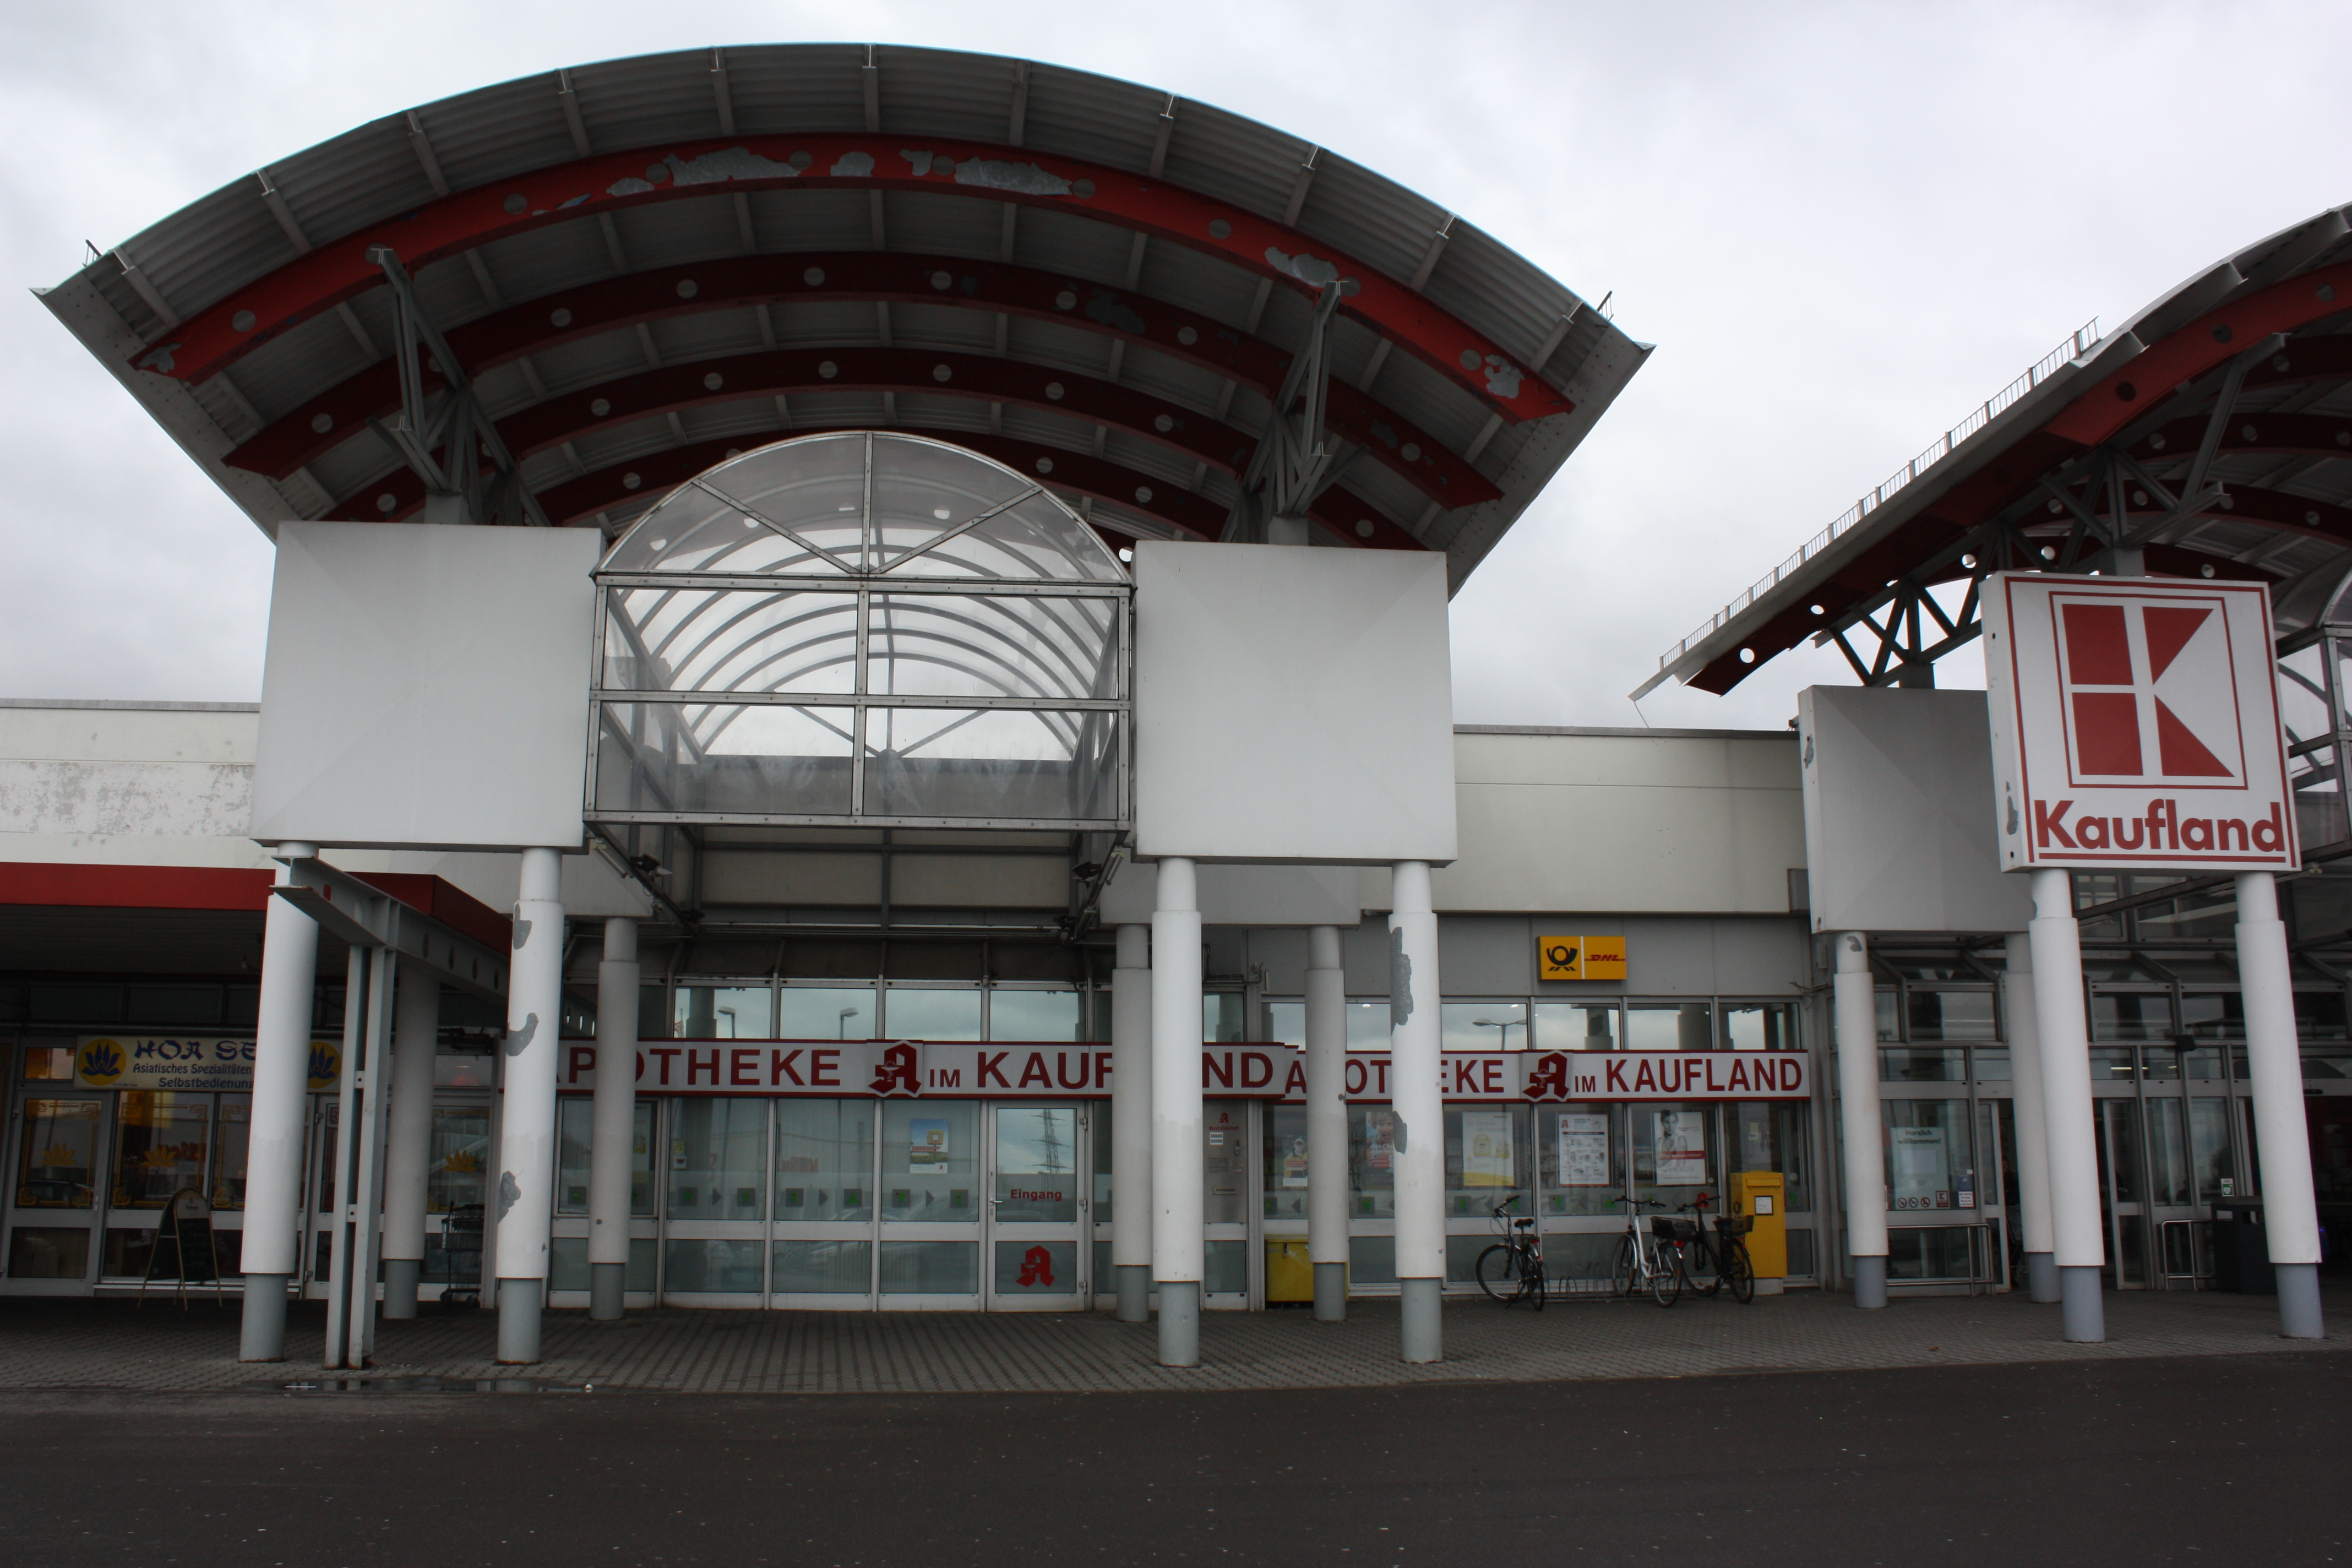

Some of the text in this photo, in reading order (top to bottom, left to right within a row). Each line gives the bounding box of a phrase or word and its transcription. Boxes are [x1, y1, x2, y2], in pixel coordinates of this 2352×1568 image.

[2034, 798, 2285, 852] Kaufland
[134, 1039, 257, 1061] HOA SE
[133, 1063, 252, 1074] Asiatisches Spezialitäten
[557, 1046, 841, 1086] PTHEKE
[929, 1069, 960, 1087] IM
[977, 1052, 1273, 1089] KAUFND
[1284, 1059, 1504, 1095] AOTKE
[1575, 1075, 1596, 1092] IM
[1606, 1059, 1802, 1093] KAUFLAND
[1011, 1189, 1062, 1201] Eingang
